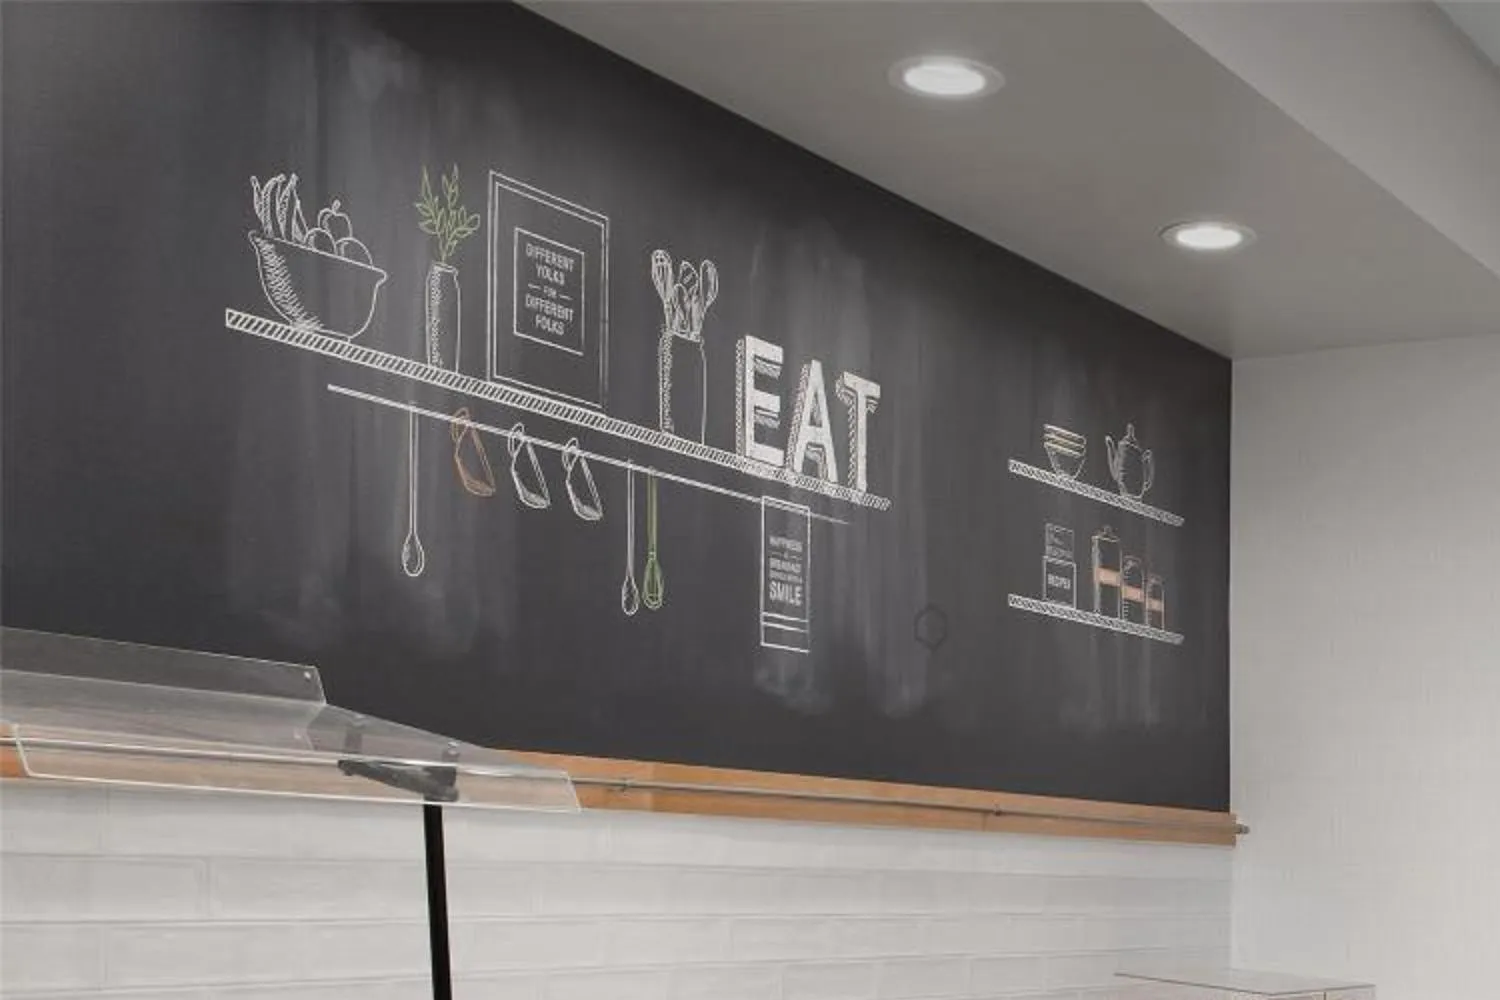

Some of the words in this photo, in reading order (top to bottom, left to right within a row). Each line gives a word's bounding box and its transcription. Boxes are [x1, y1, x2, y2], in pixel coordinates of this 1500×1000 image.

[525, 243, 575, 272] DIFFERENT
[536, 264, 566, 285] YOLKS
[525, 293, 575, 322] DIFFERENT
[535, 314, 565, 336] FOLKS
[736, 334, 882, 492] EAT
[769, 580, 803, 606] SMILE
